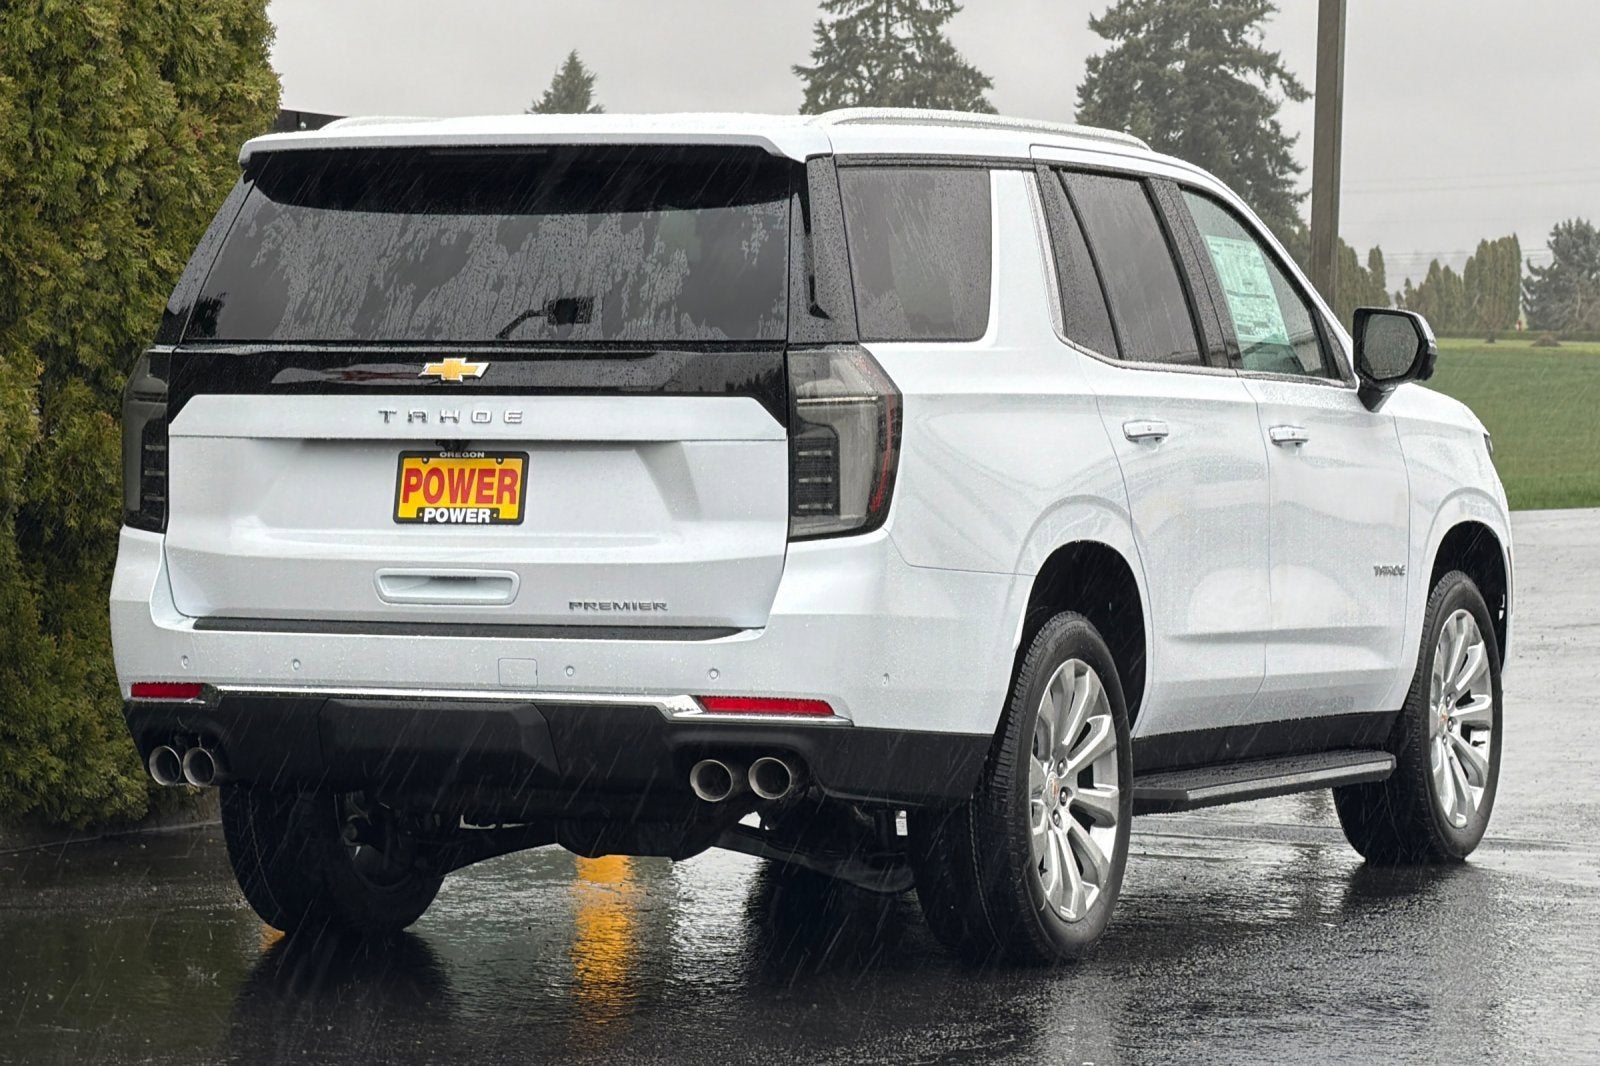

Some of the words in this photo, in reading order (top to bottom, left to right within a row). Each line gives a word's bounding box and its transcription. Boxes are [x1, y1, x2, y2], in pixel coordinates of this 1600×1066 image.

[378, 409, 523, 424] TAHOE
[439, 451, 485, 459] OREGON
[402, 467, 518, 505] POWER
[423, 508, 491, 523] POWER
[568, 601, 668, 611] PREMIER
